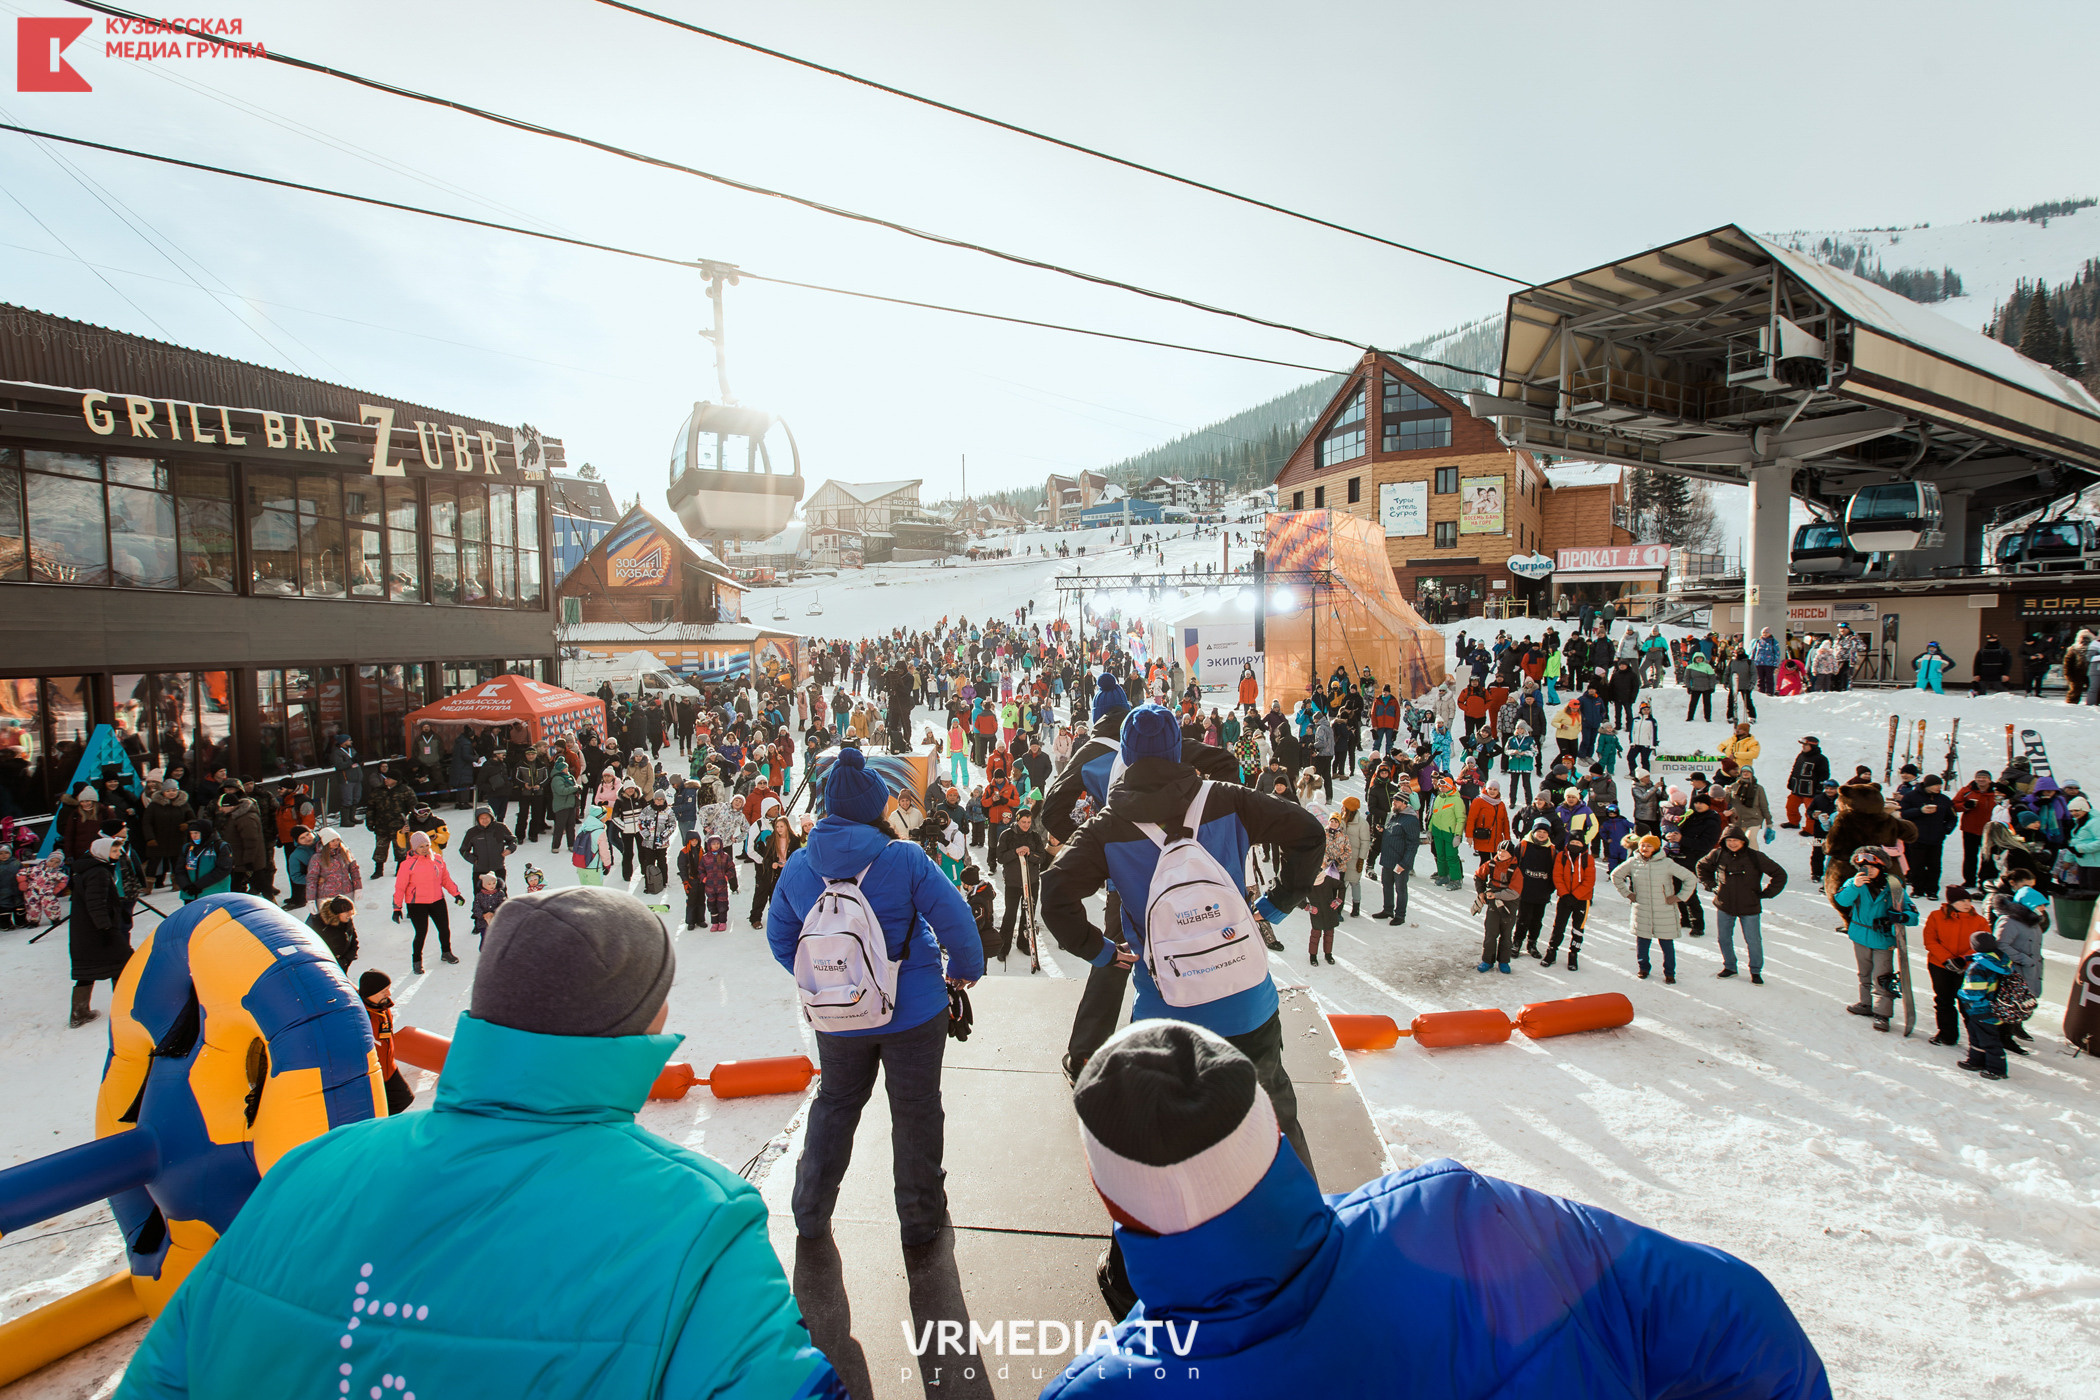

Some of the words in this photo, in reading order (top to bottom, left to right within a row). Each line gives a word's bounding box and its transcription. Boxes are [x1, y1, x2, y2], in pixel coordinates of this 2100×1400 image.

[82, 392, 247, 446] GRILL
[262, 413, 338, 454] BAR
[359, 403, 502, 477] ZUBR
[616, 558, 637, 568] 300
[1560, 550, 1620, 568] ПРОКАТ
[1628, 549, 1638, 564] #
[1510, 560, 1552, 572] Сугроб
[616, 568, 664, 578] КУЗБАСС
[1790, 608, 1827, 618] КАССЫ
[1175, 908, 1198, 919] VISIT
[1176, 910, 1221, 926] KUZBASS
[1182, 954, 1246, 978] #ОТКРОЙКУЗБАСС
